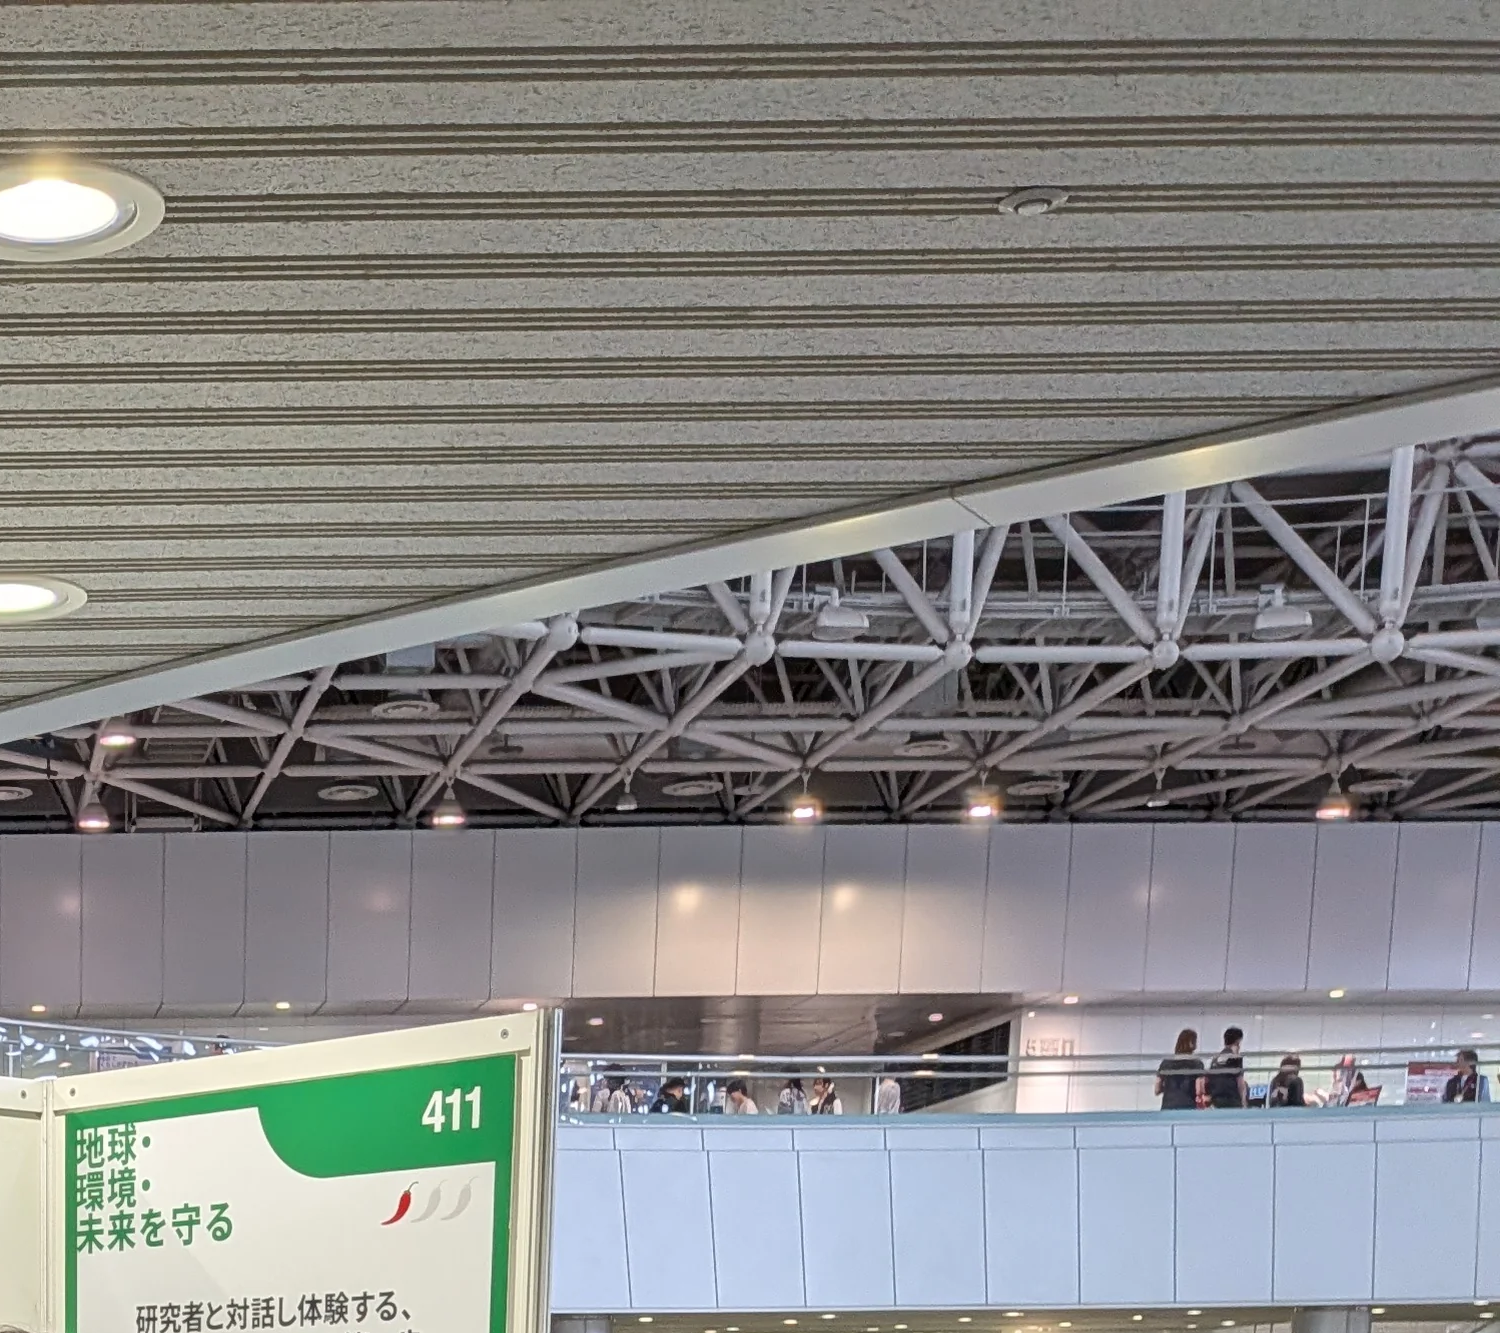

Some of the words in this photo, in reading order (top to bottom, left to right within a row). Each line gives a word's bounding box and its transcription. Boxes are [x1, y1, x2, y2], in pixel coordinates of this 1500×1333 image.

[421, 1085, 481, 1133] 411
[76, 1166, 151, 1212] 環境・
[76, 1202, 233, 1254] 未来を守る
